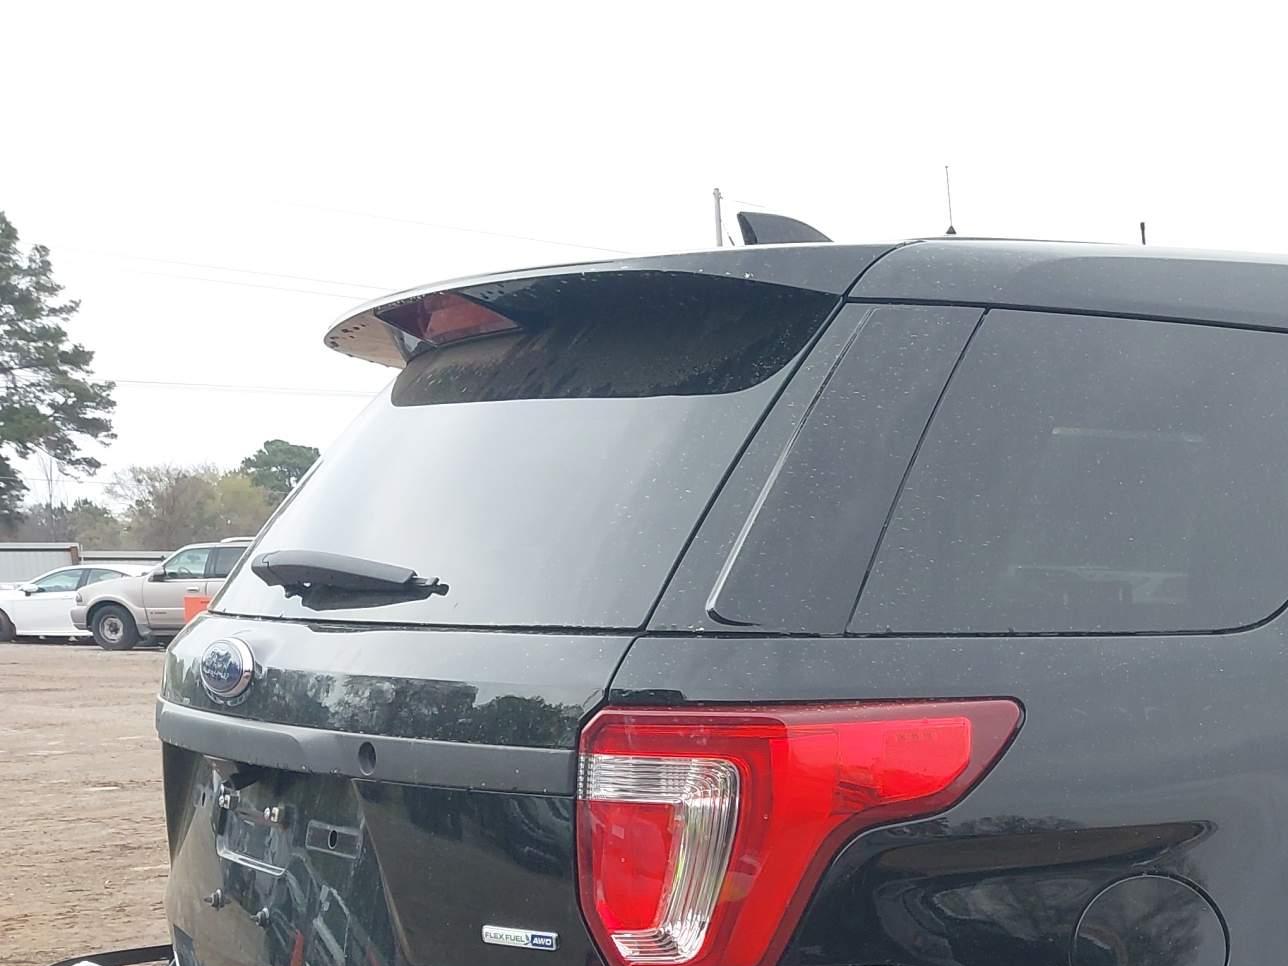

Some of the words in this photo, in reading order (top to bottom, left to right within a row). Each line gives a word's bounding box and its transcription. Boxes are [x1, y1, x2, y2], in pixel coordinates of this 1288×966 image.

[484, 931, 504, 940] FLEX
[505, 934, 526, 943] FUEL
[532, 936, 552, 946] AWD
